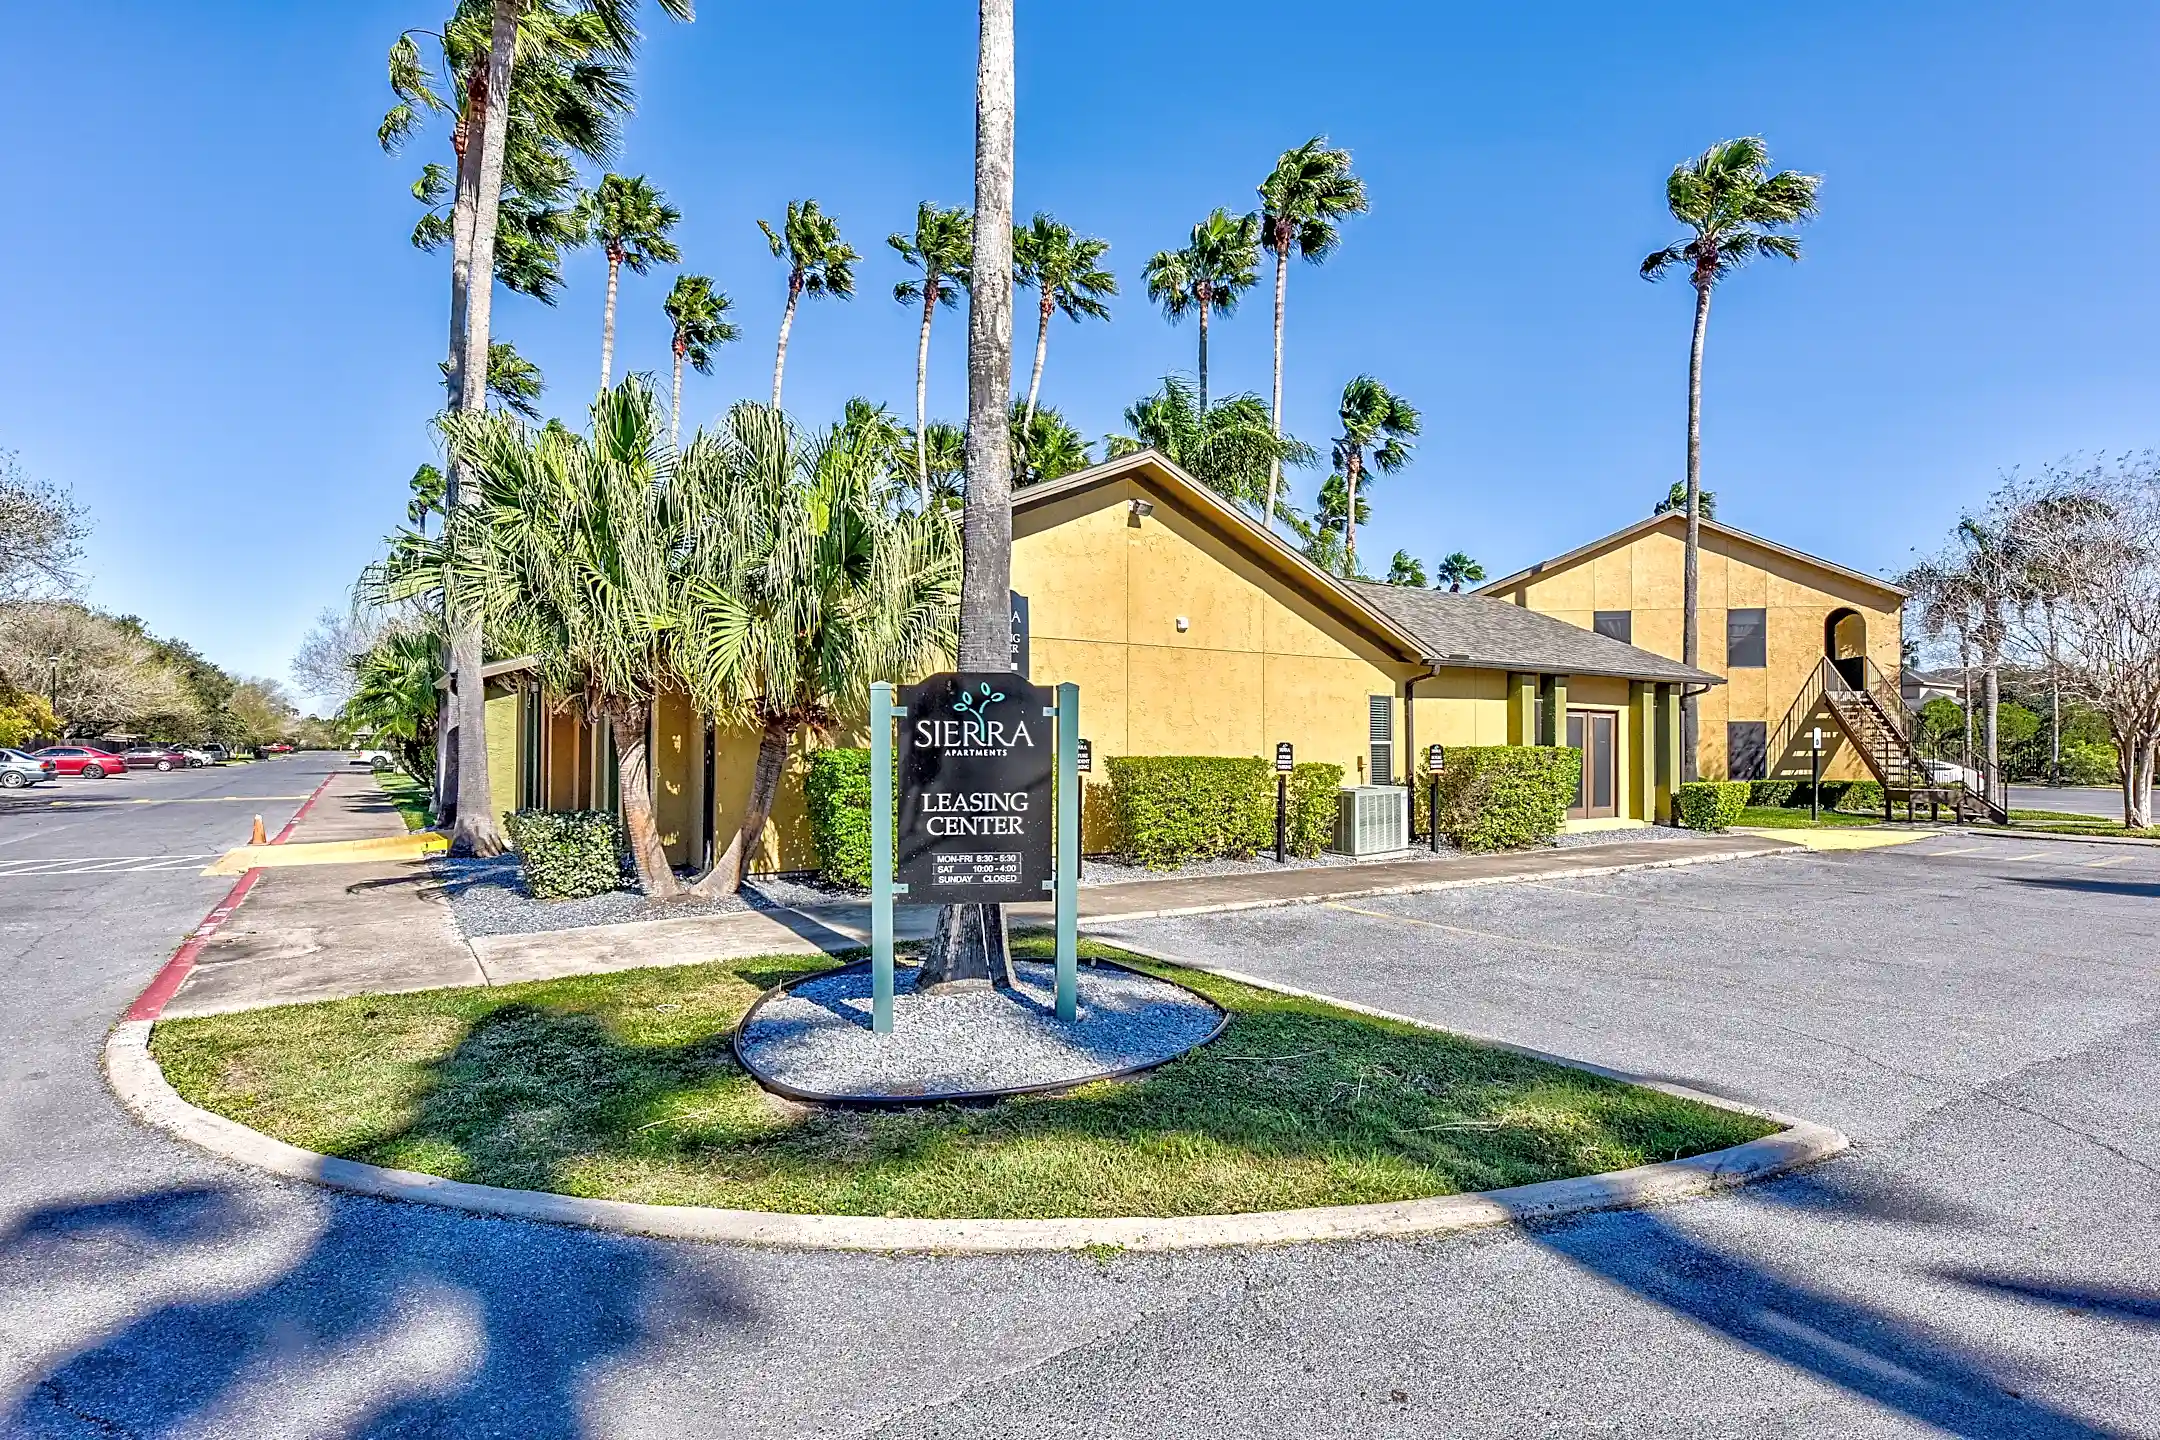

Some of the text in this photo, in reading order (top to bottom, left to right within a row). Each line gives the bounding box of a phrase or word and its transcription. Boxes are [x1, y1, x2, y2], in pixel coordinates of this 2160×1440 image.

[915, 720, 1035, 747] SIERRA
[944, 748, 1008, 756] APARTMENTS
[921, 792, 1029, 812] LEASING
[926, 816, 1025, 836] CENTER
[937, 854, 973, 863] MON-FRI
